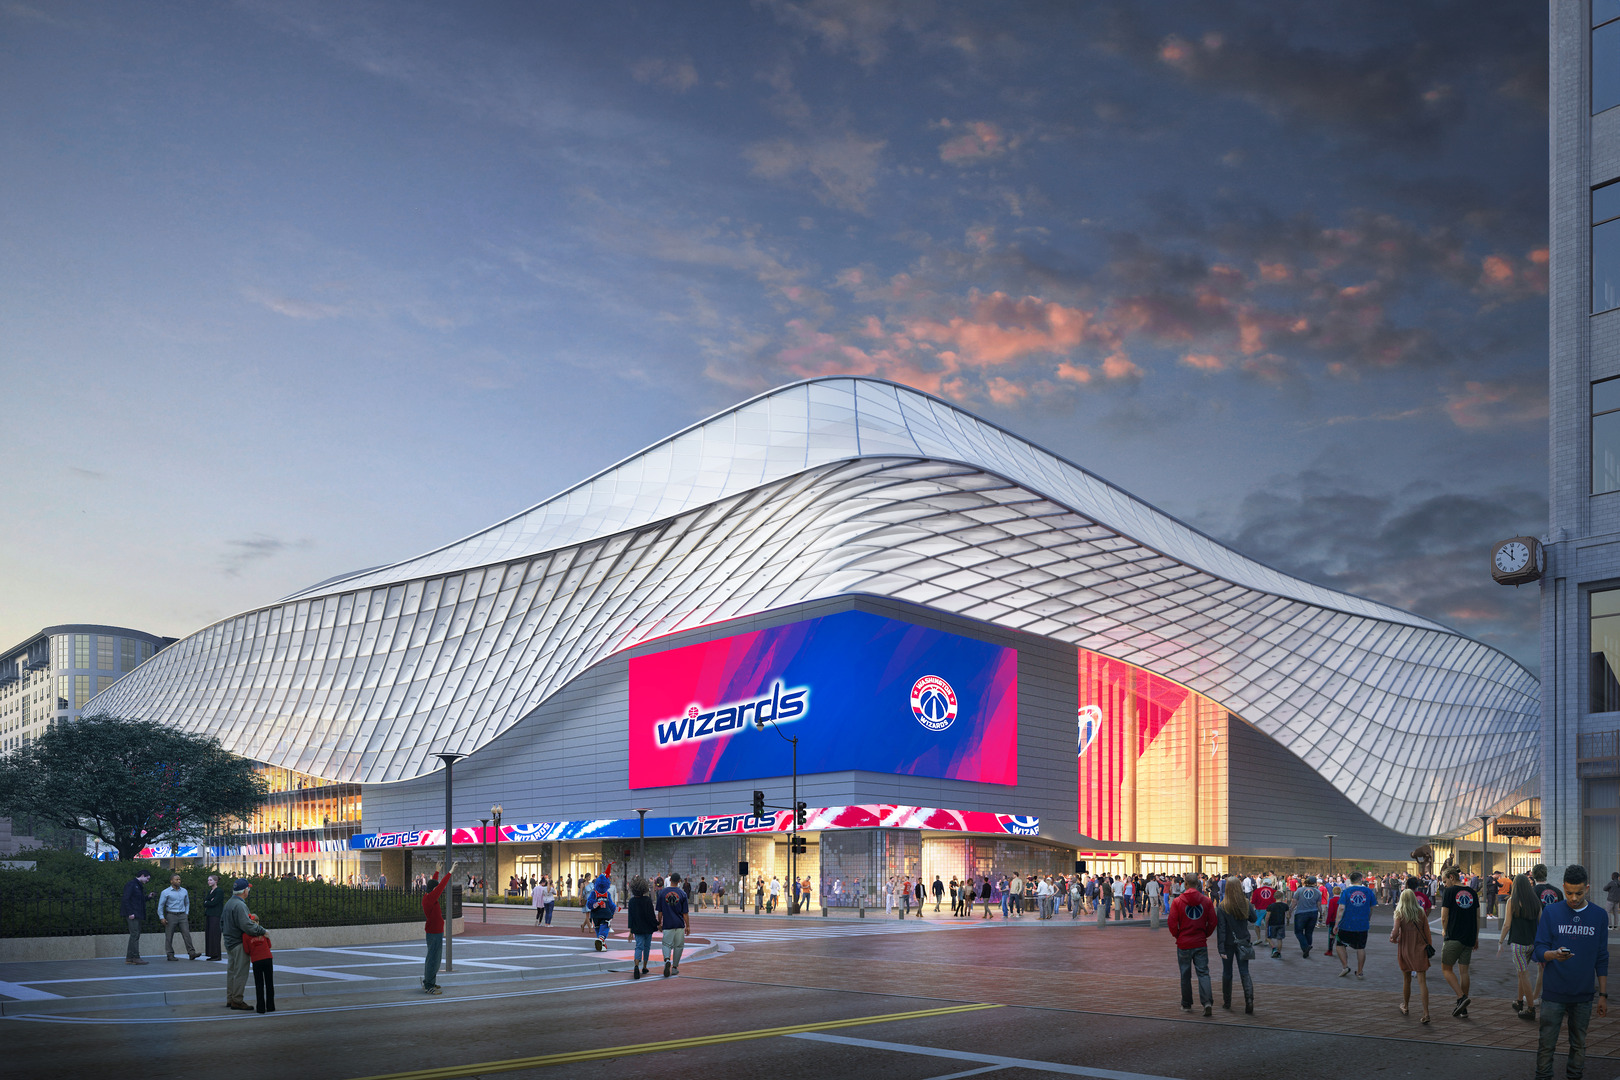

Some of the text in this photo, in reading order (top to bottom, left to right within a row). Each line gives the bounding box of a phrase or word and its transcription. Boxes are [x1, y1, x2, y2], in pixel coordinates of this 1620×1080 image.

[916, 677, 953, 696] WASHINGTON
[657, 681, 808, 745] wizards
[920, 715, 949, 729] WIZARDS
[514, 823, 551, 842] WIZARDS
[671, 810, 777, 836] wizards
[365, 830, 420, 848] wizards
[1558, 924, 1596, 936] WIZARDS
